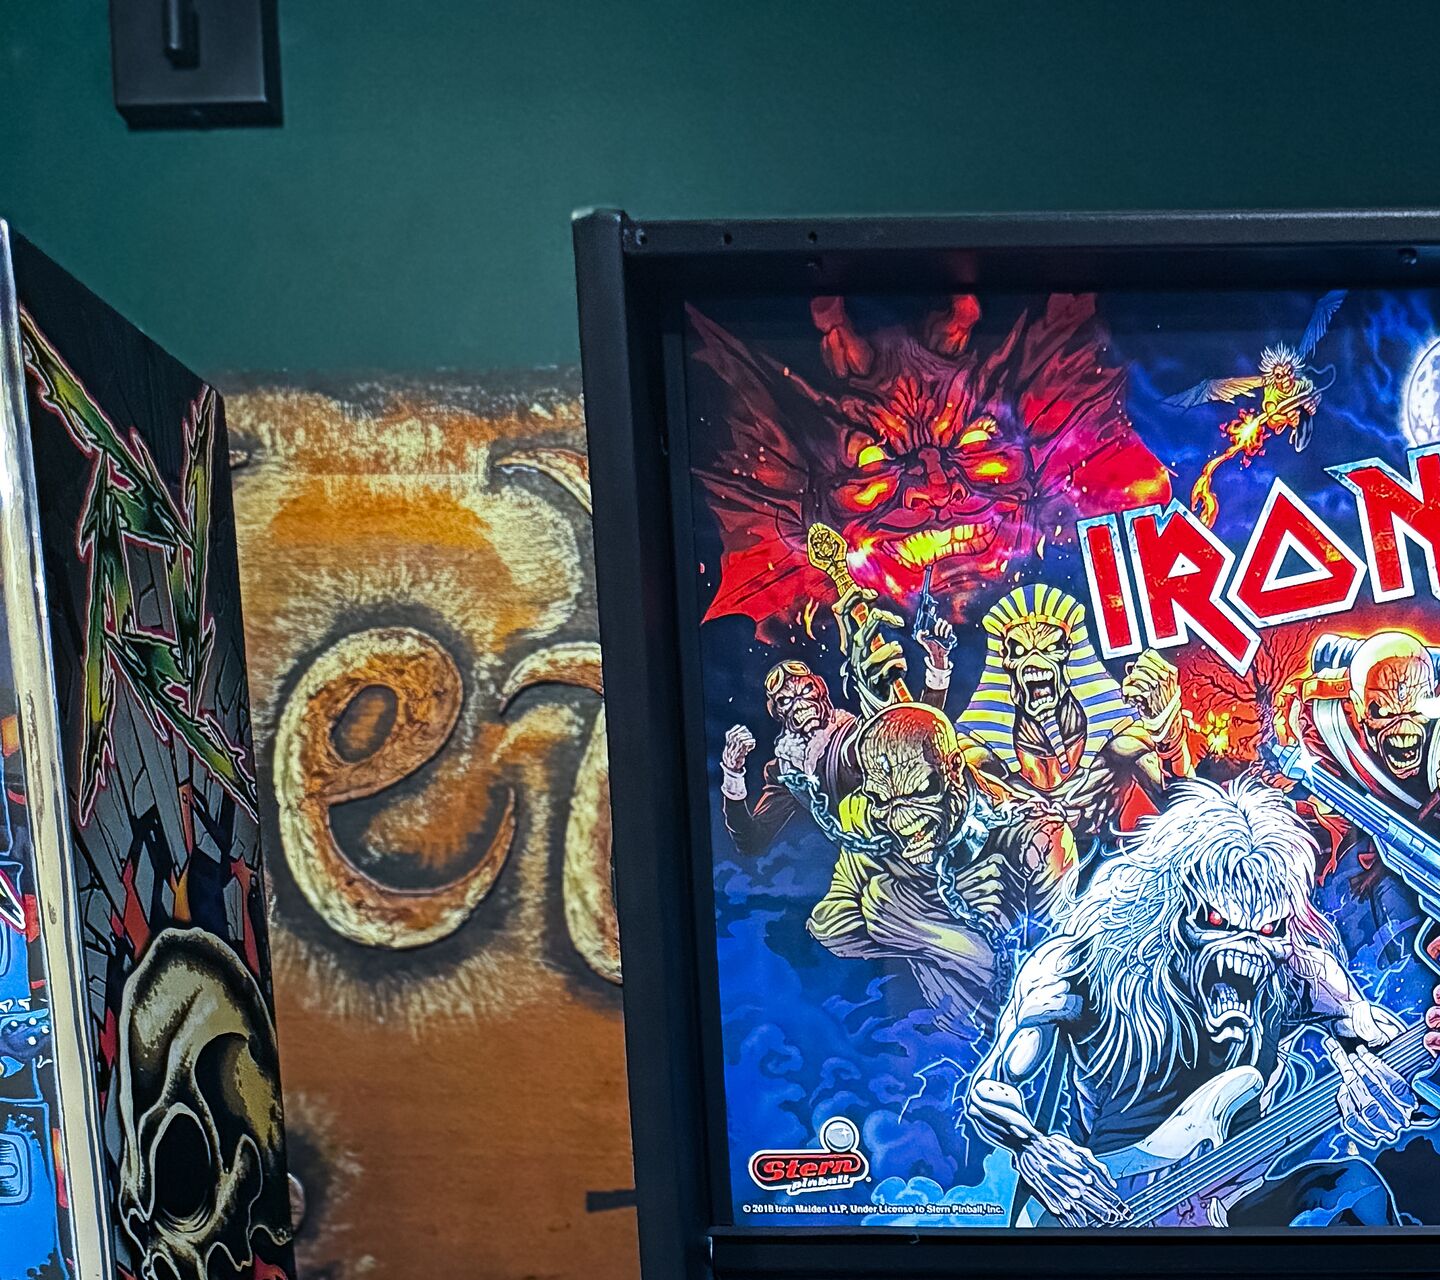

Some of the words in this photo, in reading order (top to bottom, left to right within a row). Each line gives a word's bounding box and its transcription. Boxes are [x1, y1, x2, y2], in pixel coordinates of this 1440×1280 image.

[763, 1157, 854, 1180] Stern
[792, 1175, 850, 1191] pinball
[752, 1204, 774, 1214] 2018
[775, 1204, 794, 1214] Iron
[795, 1204, 828, 1214] Maiden
[850, 1204, 878, 1214] Under
[879, 1204, 914, 1214] License
[915, 1205, 925, 1214] to
[926, 1204, 951, 1214] Stern
[952, 1204, 986, 1216] Pinball,
[987, 1204, 1004, 1214] Inc.
